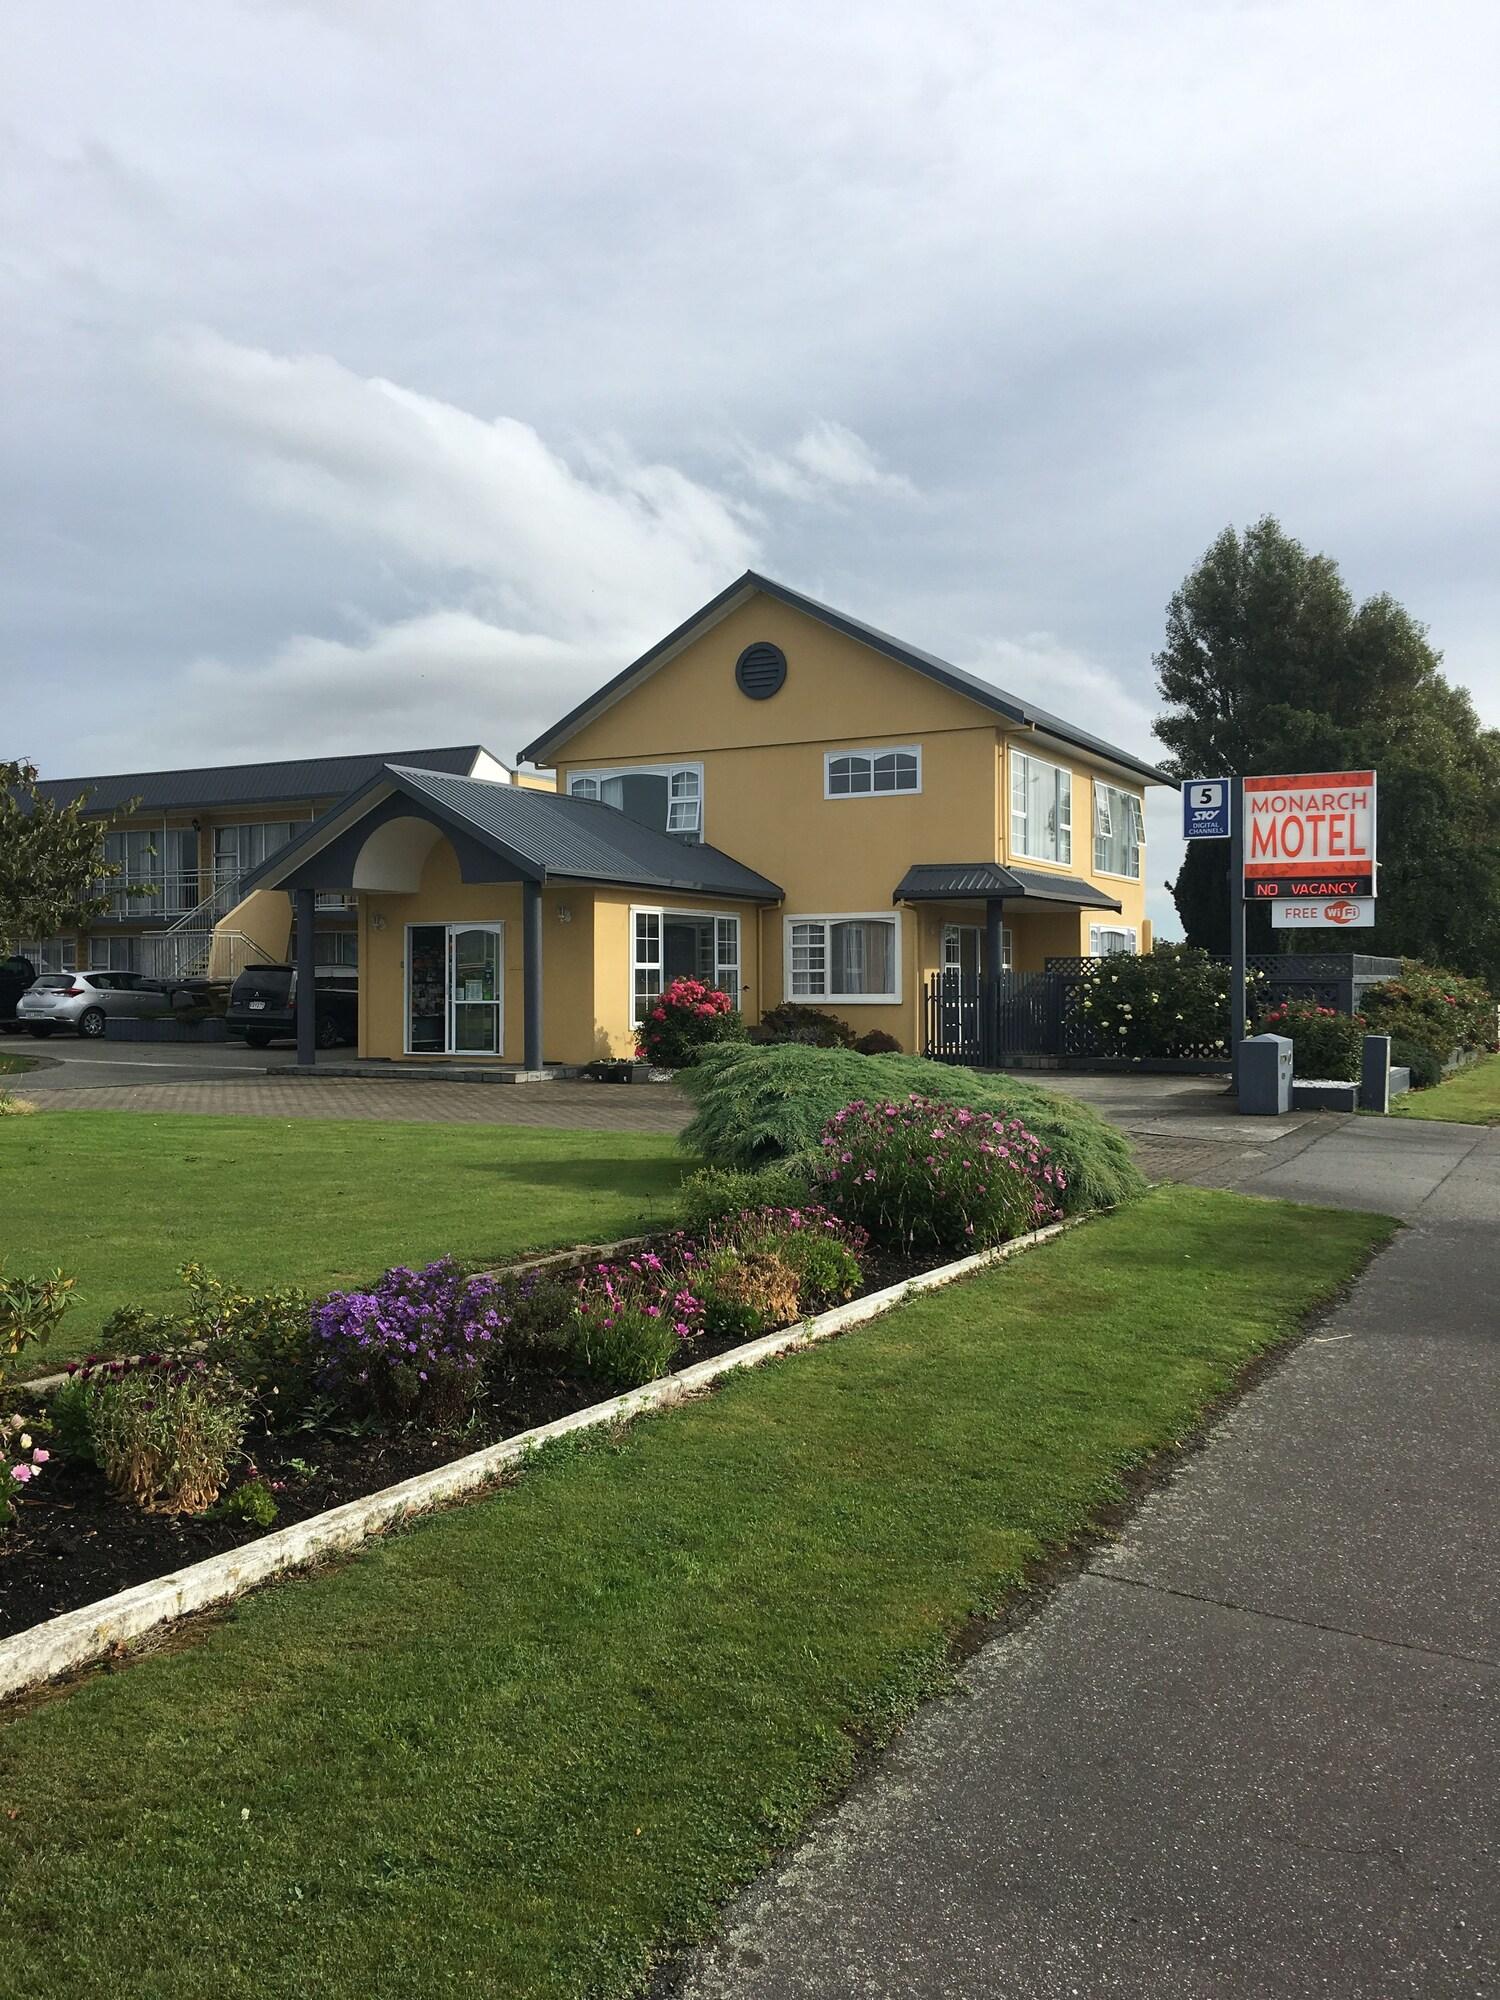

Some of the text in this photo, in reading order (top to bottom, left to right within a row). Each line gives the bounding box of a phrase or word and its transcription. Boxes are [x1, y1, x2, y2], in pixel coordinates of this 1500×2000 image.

[1200, 788, 1212, 805] 5
[1251, 792, 1367, 814] MONARCH
[1192, 810, 1220, 821] SKY
[1188, 827, 1224, 835] CHANNELS
[1251, 813, 1366, 858] MOTEL
[1257, 882, 1358, 896] NO VACANCY
[1285, 907, 1318, 919] FREE
